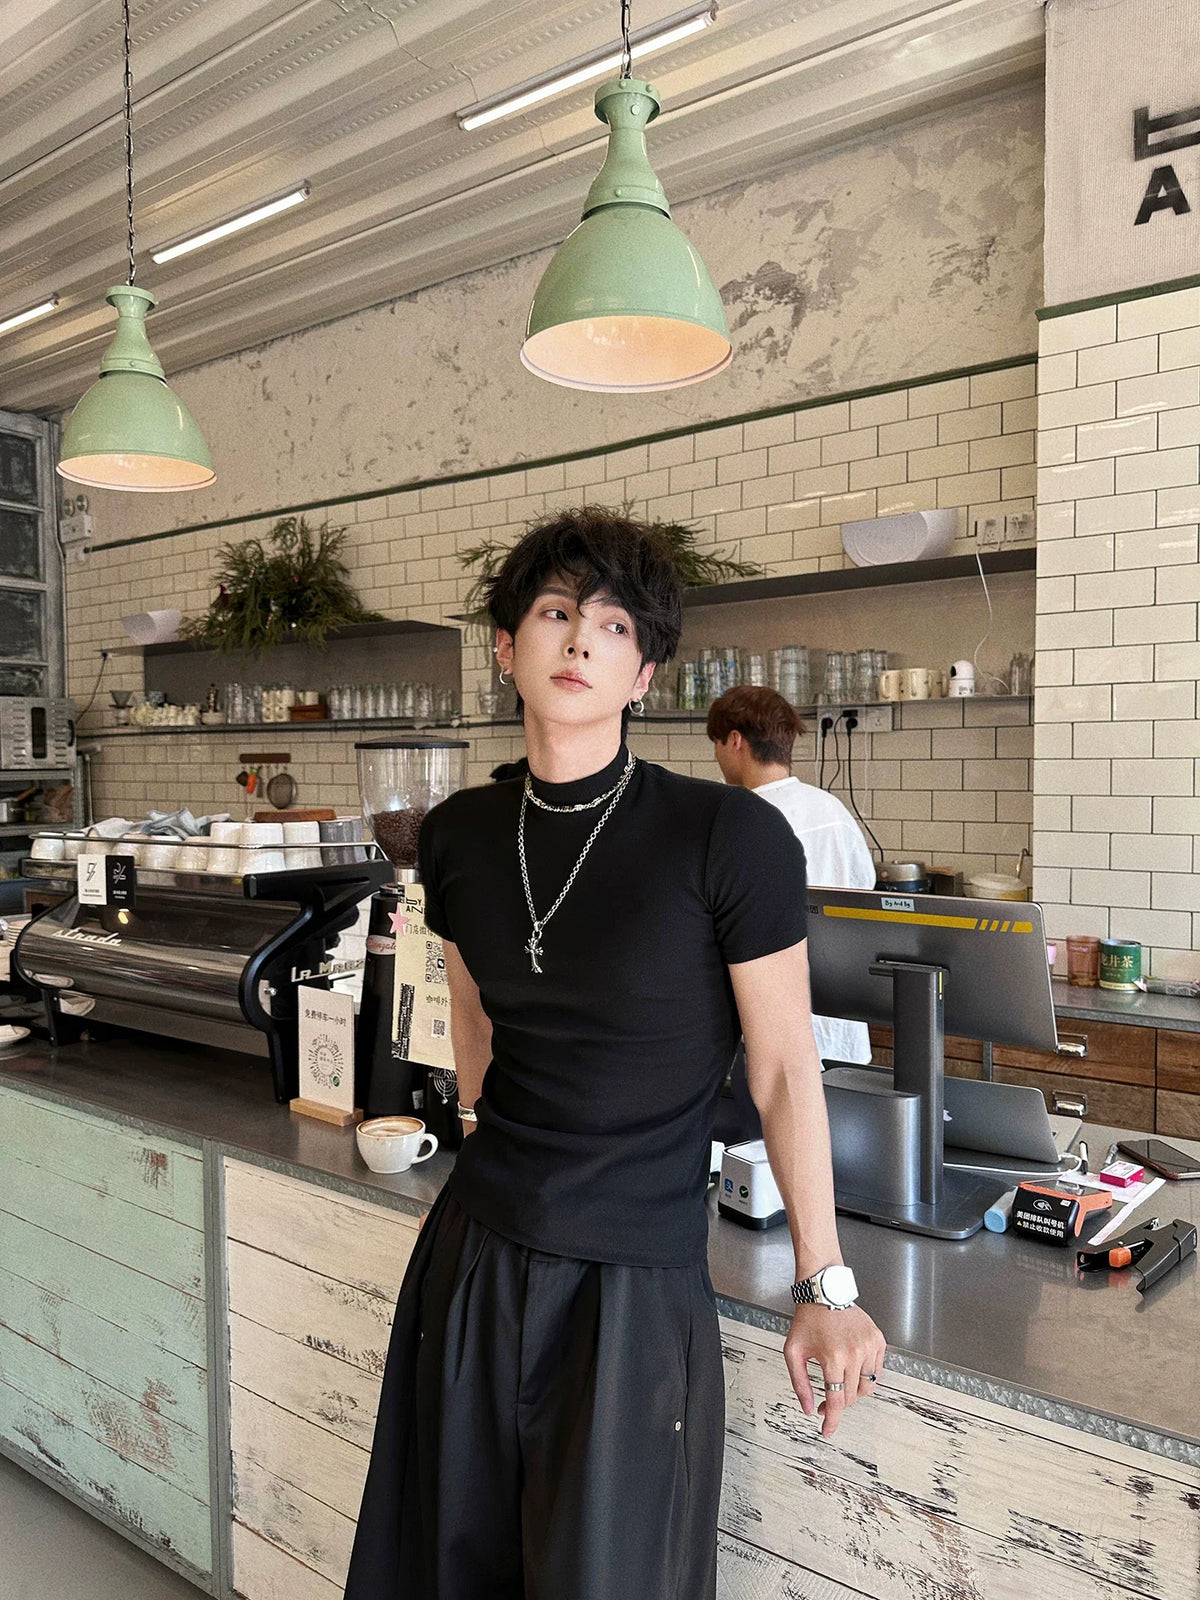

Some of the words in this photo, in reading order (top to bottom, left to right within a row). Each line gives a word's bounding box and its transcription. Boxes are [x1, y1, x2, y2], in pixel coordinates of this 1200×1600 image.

[1134, 165, 1191, 226] A
[425, 994, 453, 1007] 咖啡外
[1016, 1210, 1065, 1230] 美团排队叫号机
[1022, 1221, 1064, 1239] 禁止收款使用
